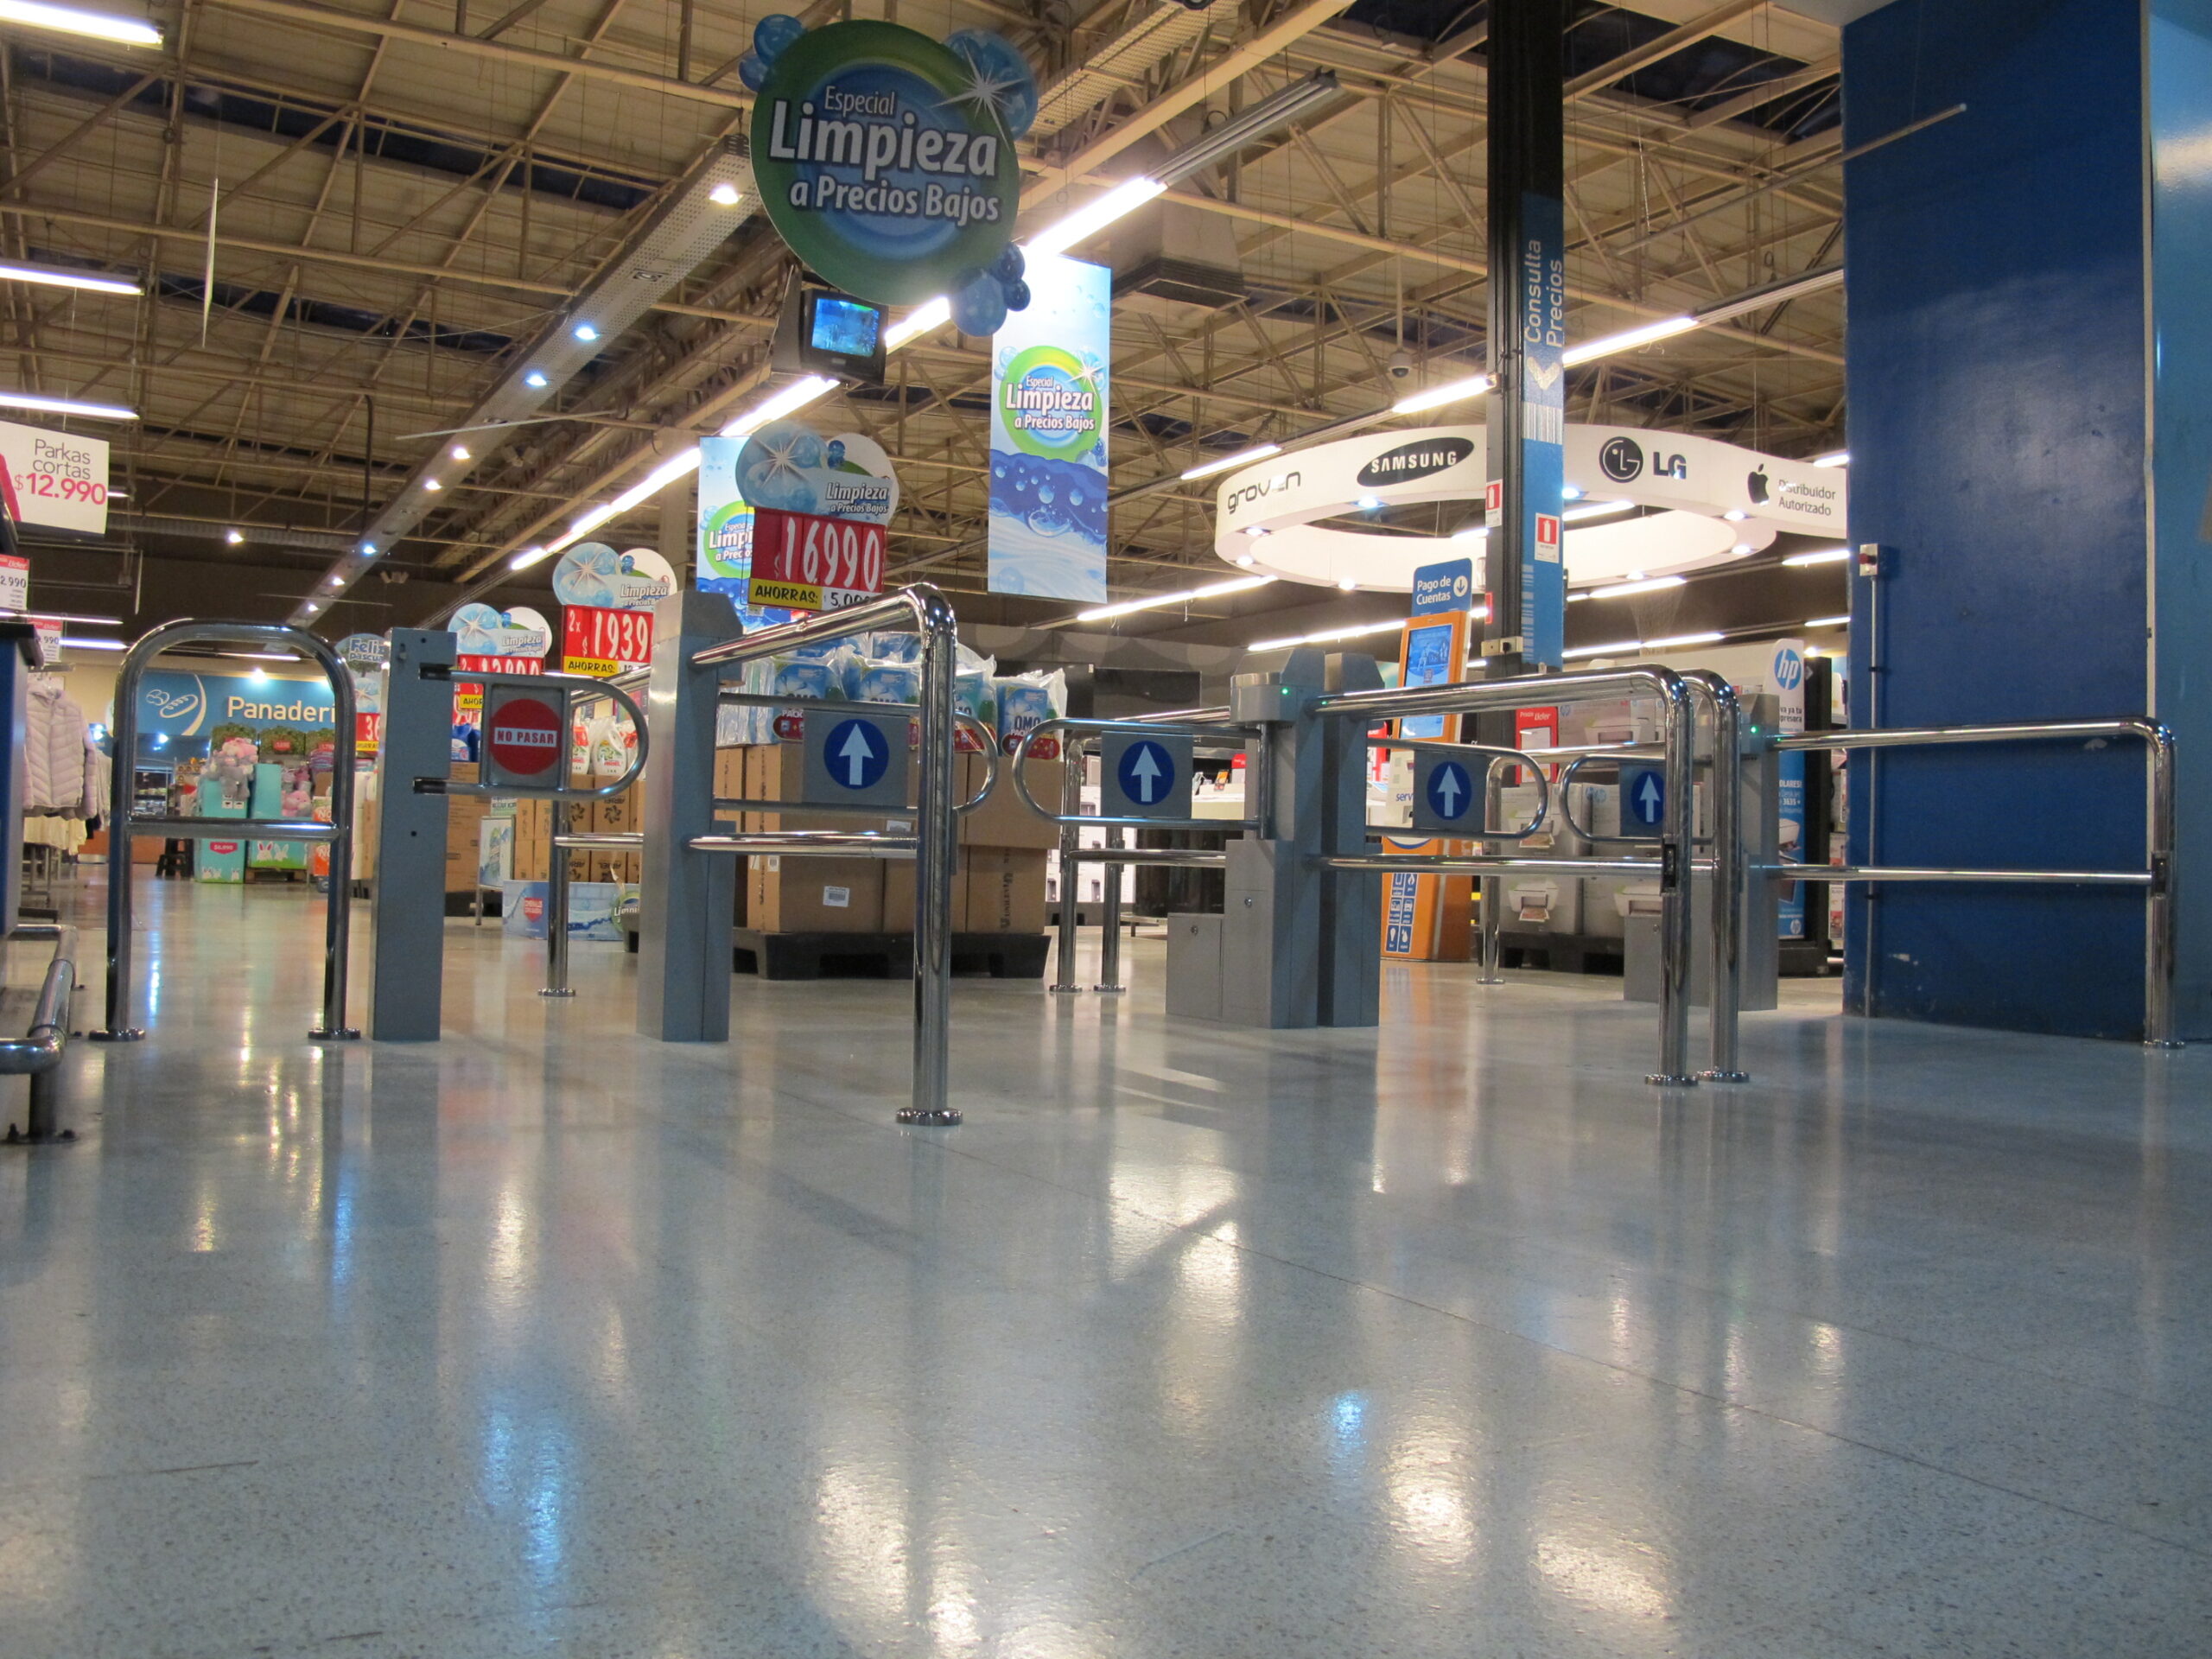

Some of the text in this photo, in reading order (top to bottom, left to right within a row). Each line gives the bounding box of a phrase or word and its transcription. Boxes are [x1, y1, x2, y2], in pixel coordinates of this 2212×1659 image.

[823, 85, 897, 118] Especial
[768, 99, 999, 181] Limpieza
[789, 175, 1000, 227] a Precios Bajos
[1523, 238, 1541, 343] Consulta
[1545, 259, 1563, 348] Precios
[1026, 375, 1054, 390] Especial
[1005, 383, 1095, 416] Limpieza
[1014, 414, 1096, 434] a Precios Bajos
[34, 438, 91, 465] Parkas
[1370, 450, 1458, 474] SAMSUNG
[32, 459, 91, 480] cortas
[1652, 451, 1688, 480] LG
[826, 481, 889, 504] Limpieza
[1227, 471, 1301, 514] grovn
[1778, 479, 1836, 501] Dstribuidor
[837, 504, 865, 514] Precios
[867, 505, 888, 517] Bajos
[1778, 497, 1833, 517] Autorizado
[722, 548, 753, 561] Preco
[620, 583, 668, 600] Limpieza
[754, 584, 818, 604] AHORRAS:
[1416, 575, 1451, 594] Pago de
[1416, 591, 1451, 606] Cuentas
[569, 609, 581, 632] 2x
[349, 638, 387, 655] Feliz
[1776, 648, 1801, 690] hp
[496, 729, 556, 745] NO PASAR
[1395, 793, 1414, 803] serv
